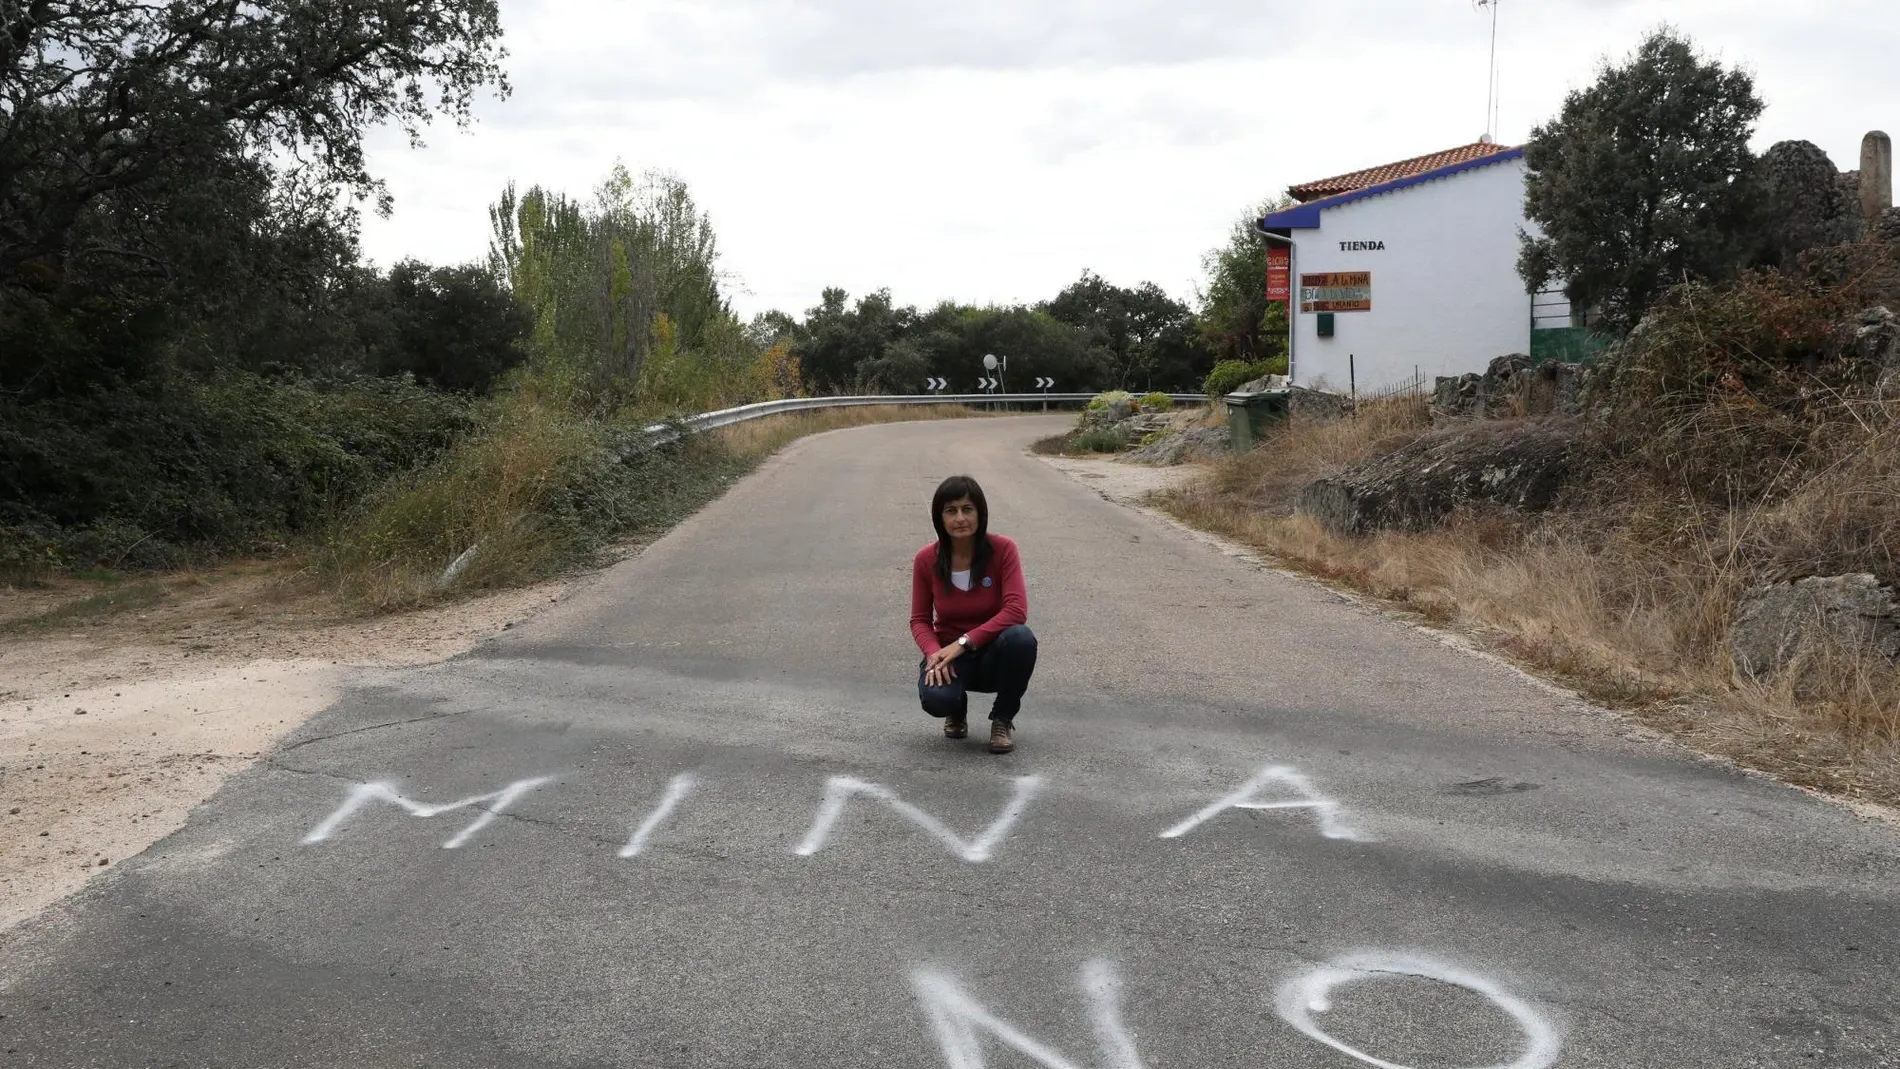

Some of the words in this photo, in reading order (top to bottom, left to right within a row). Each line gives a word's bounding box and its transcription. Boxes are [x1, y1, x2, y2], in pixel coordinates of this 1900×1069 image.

[1339, 241, 1385, 251] TIENDA
[301, 765, 1380, 863] MINA
[910, 948, 1561, 1069] NO
